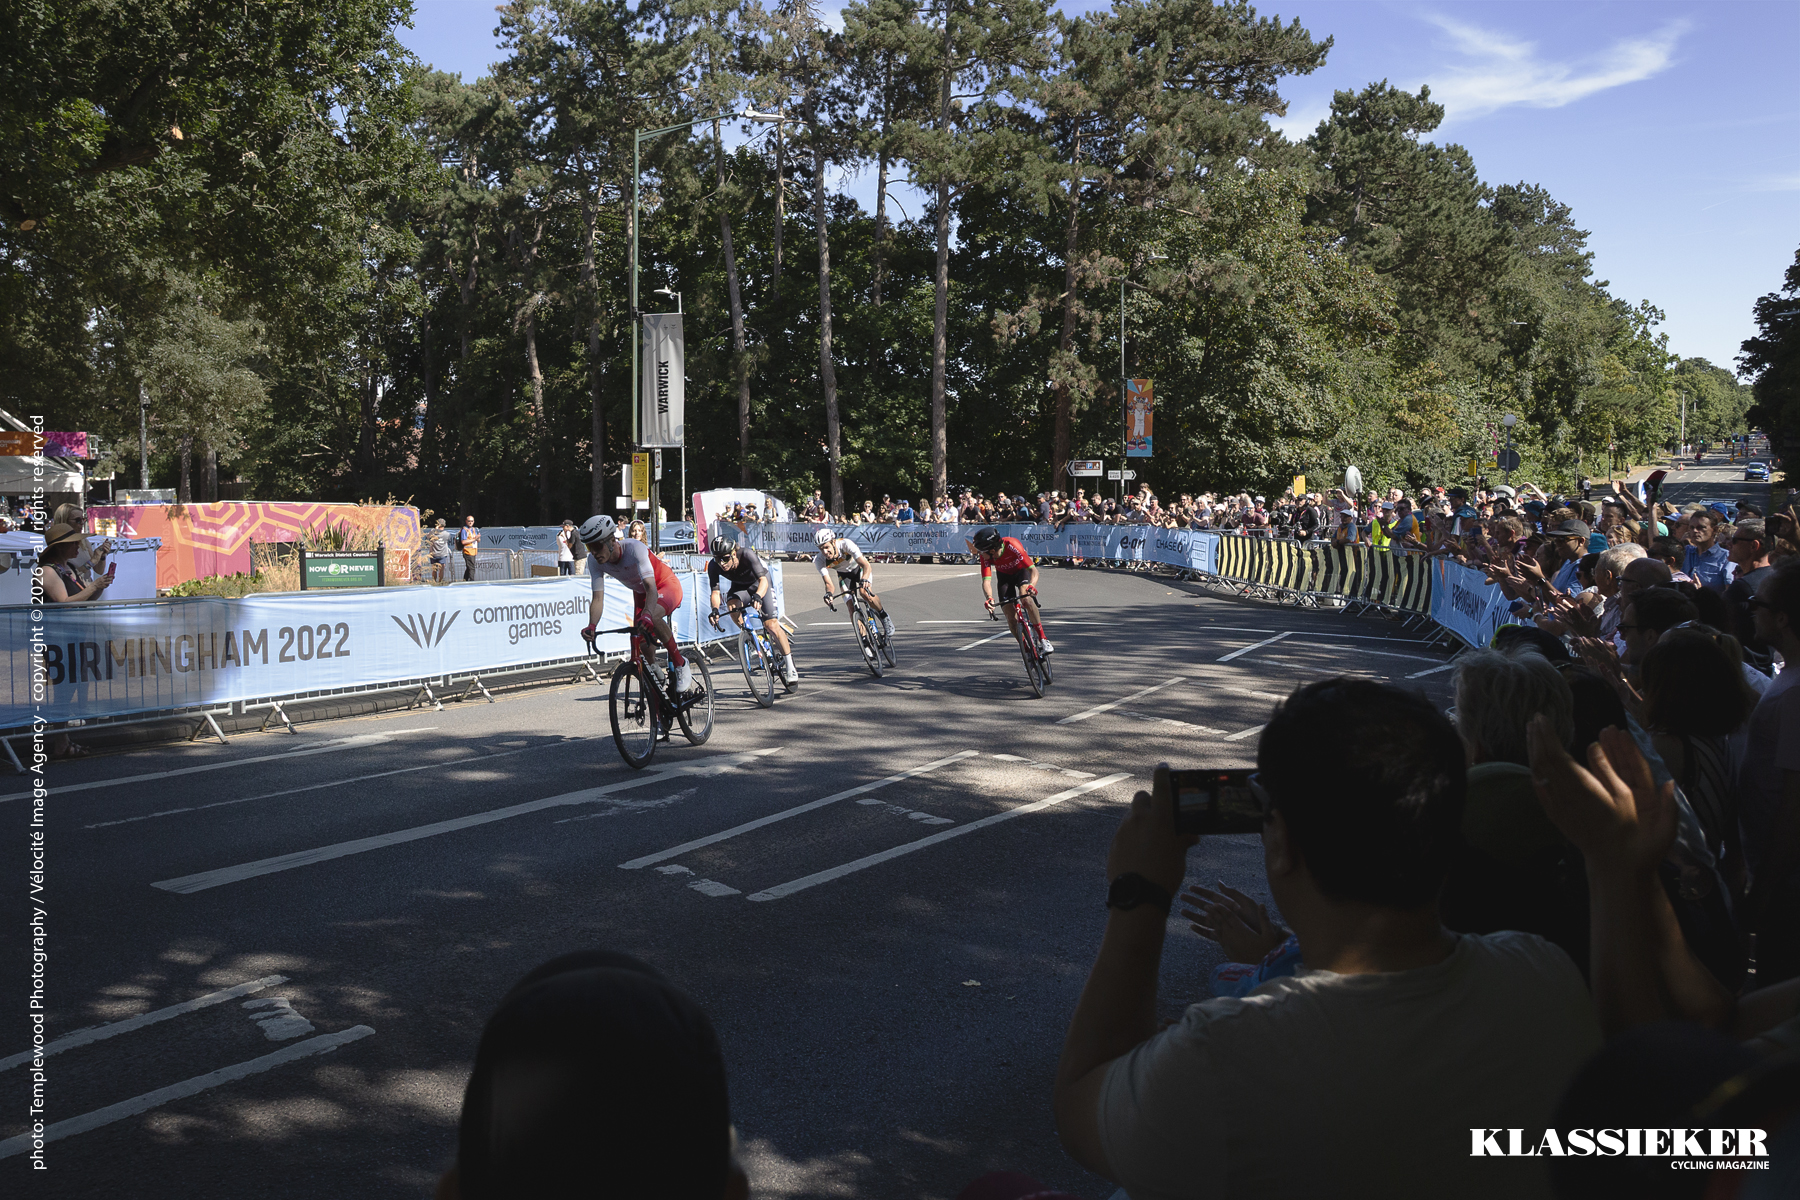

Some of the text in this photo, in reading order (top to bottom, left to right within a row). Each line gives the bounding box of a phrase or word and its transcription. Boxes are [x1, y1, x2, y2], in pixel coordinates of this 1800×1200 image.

[658, 360, 669, 414] WARWICK
[893, 530, 948, 538] commonwealth
[908, 537, 933, 546] games
[1021, 533, 1055, 541] LONGINES
[1156, 539, 1176, 552] CHASE
[473, 596, 591, 624] commonwealth
[508, 619, 562, 645] games
[46, 622, 351, 686] BIRMINGHAM 2022
